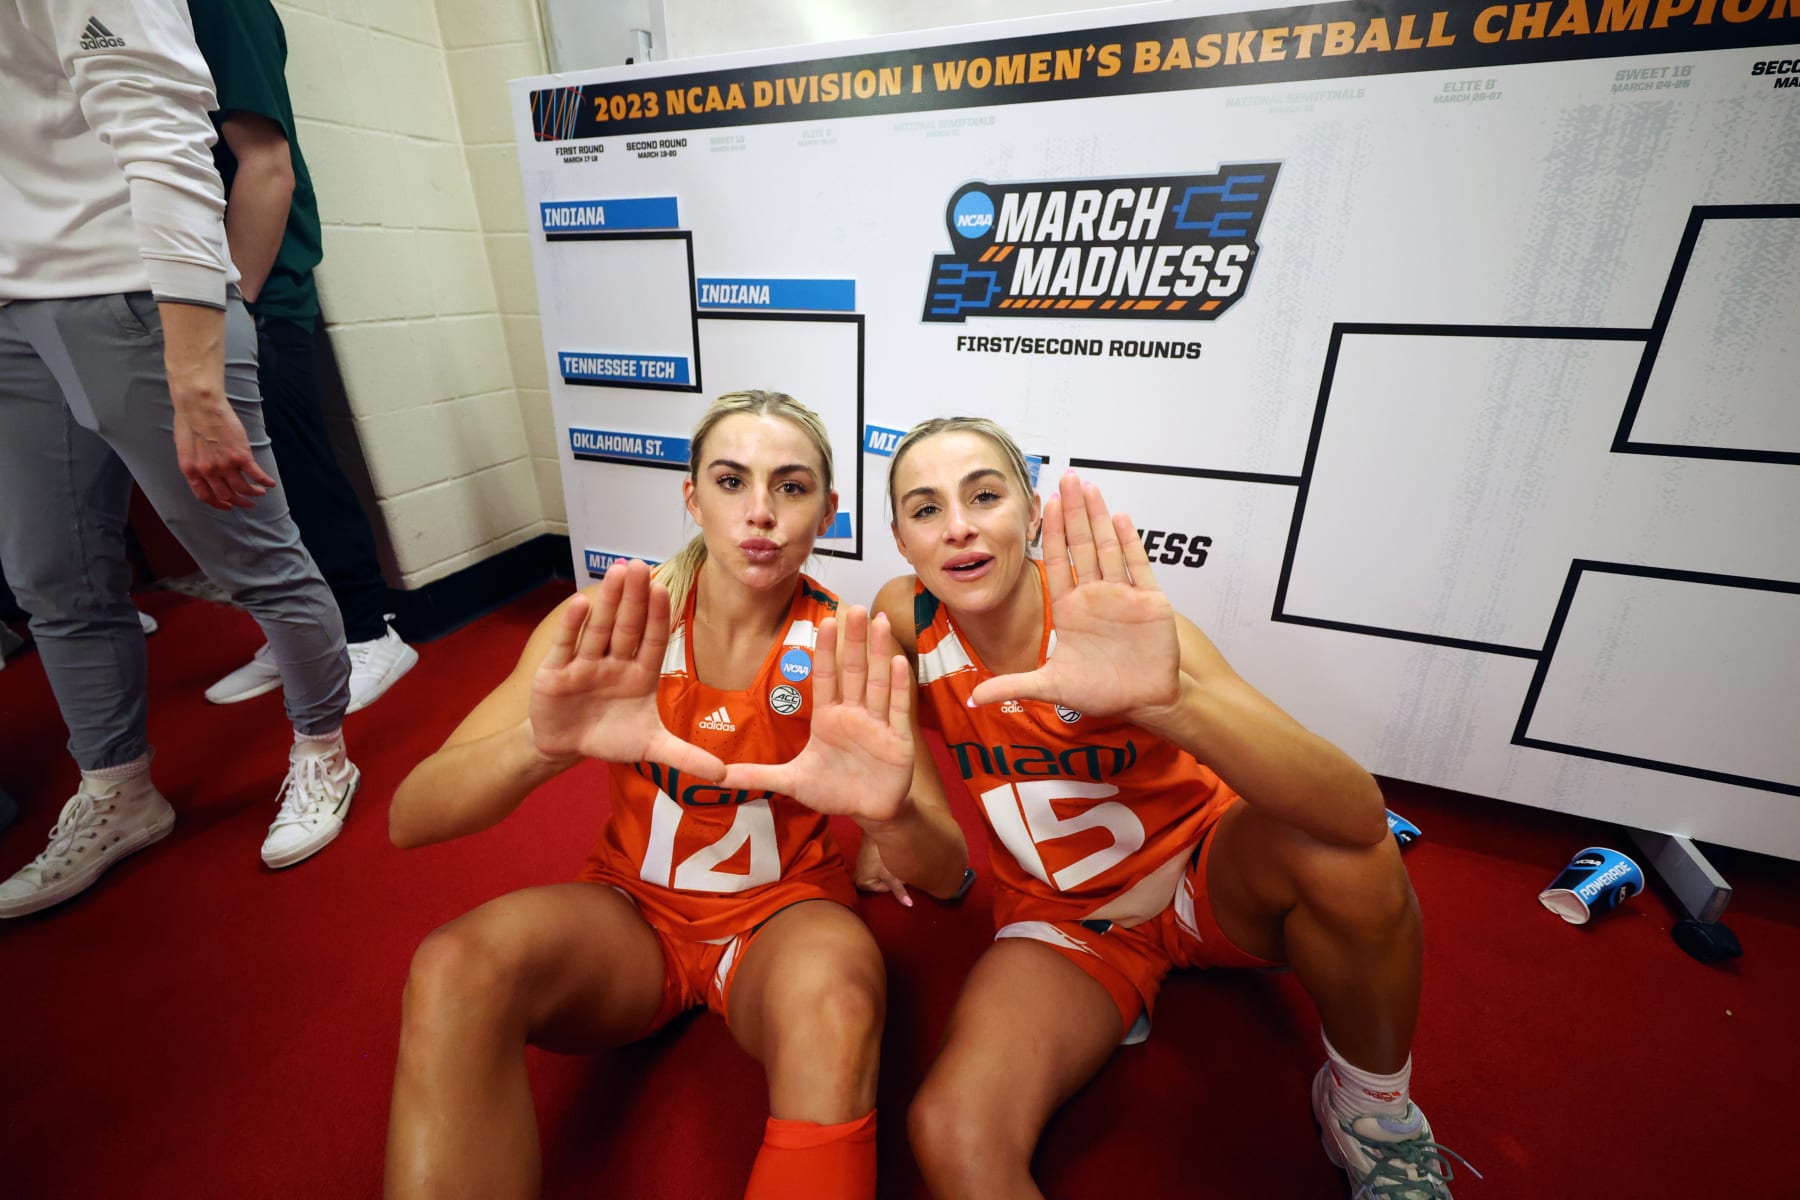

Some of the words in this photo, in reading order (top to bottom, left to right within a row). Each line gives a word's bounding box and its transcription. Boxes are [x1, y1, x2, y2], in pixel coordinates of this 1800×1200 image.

[80, 36, 126, 50] adidas
[594, 91, 660, 122] 2023
[666, 83, 747, 116] NCAA
[753, 66, 903, 108] DIVISION
[911, 64, 924, 94] I
[933, 44, 1122, 92] WOMEN'S
[1133, 13, 1456, 74] BASKETBALL
[1473, 0, 1800, 44] CHAMPIO
[1615, 66, 1670, 82] SWEET
[1443, 81, 1483, 92] ELITE
[1485, 79, 1497, 90] 8
[1611, 81, 1653, 93] MARCH
[1773, 77, 1800, 89] MA
[1433, 93, 1471, 105] MARCH
[556, 147, 577, 156] FIRST
[579, 144, 604, 154] ROUND
[626, 141, 658, 151] SECOND
[659, 138, 687, 149] ROUND
[563, 155, 583, 163] MARCH
[637, 151, 659, 159] MARCH
[544, 206, 605, 227] INDIANA
[957, 213, 993, 227] NCAA
[994, 186, 1171, 243] MARCH
[1010, 244, 1251, 297] MADNESS
[701, 284, 770, 305] INDIANA
[956, 335, 1103, 356] FIRST/SECOND
[1109, 339, 1202, 360] ROUNDS
[564, 357, 637, 377] TENNESSEE
[640, 360, 675, 379] TECH
[573, 432, 643, 453] OKLAHOMA
[645, 440, 664, 456] ST.
[868, 430, 904, 451] MI
[1137, 529, 1212, 568] ESS
[783, 663, 810, 676] NCAA
[774, 693, 800, 704] ACC
[699, 720, 736, 732] adidas
[640, 787, 781, 893] 14
[980, 780, 1146, 892] 15
[1580, 861, 1632, 900] POWERADE
